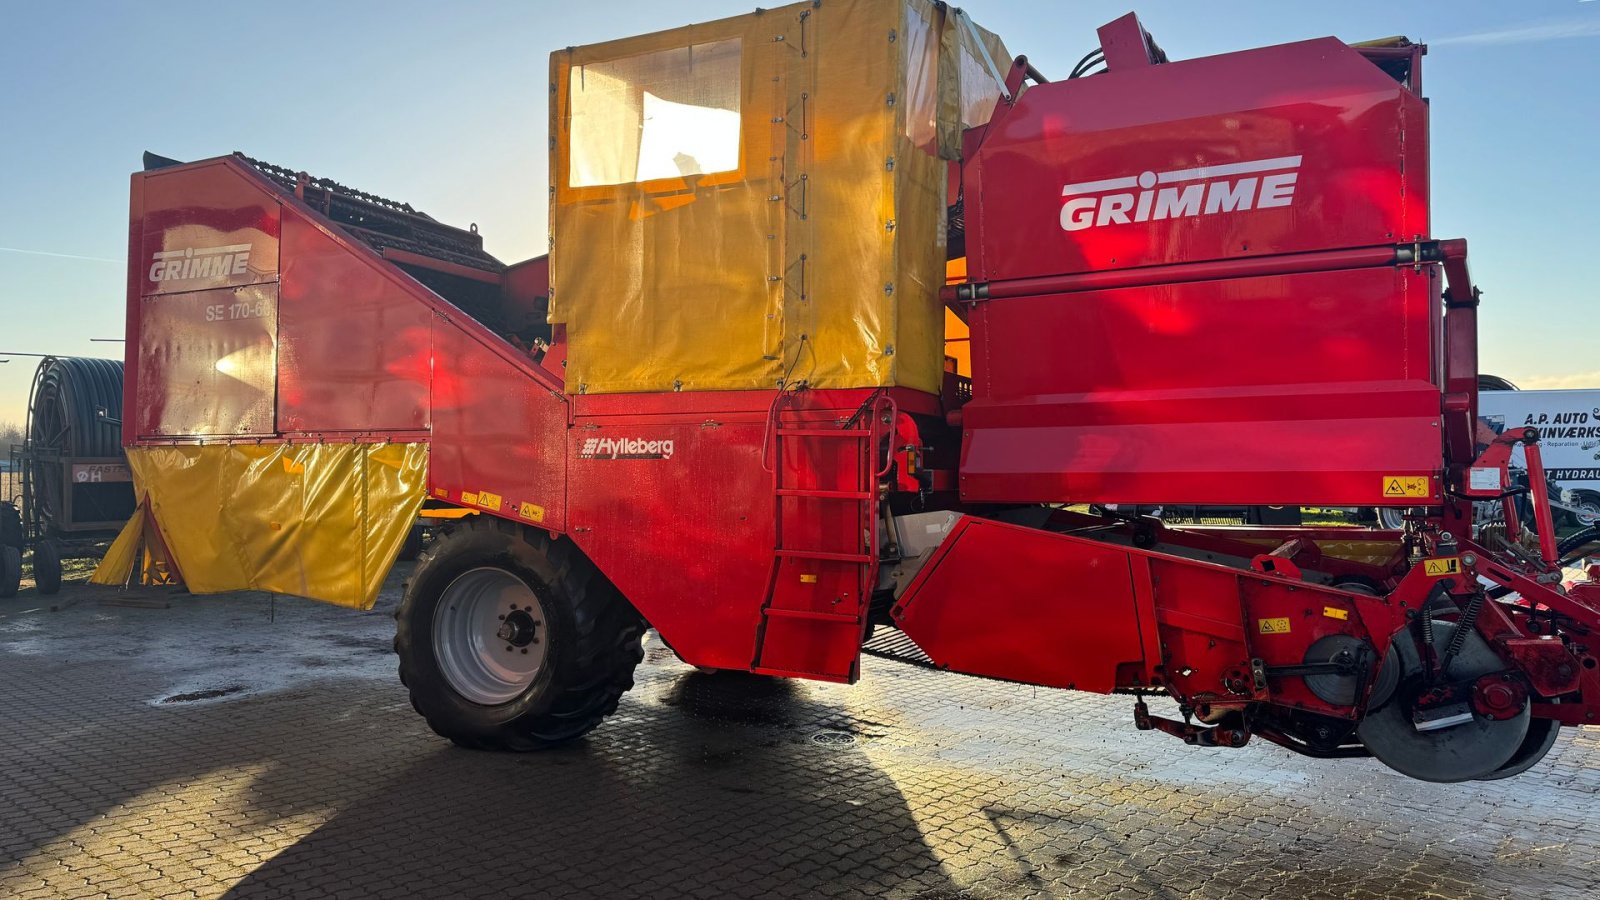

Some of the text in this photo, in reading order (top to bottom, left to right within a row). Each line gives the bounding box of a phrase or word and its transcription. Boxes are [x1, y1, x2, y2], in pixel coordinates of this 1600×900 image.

[1060, 171, 1299, 232] GRIMME
[149, 247, 250, 282] GRIMME
[206, 304, 225, 322] SE
[1524, 412, 1588, 425] A.P. AUTO
